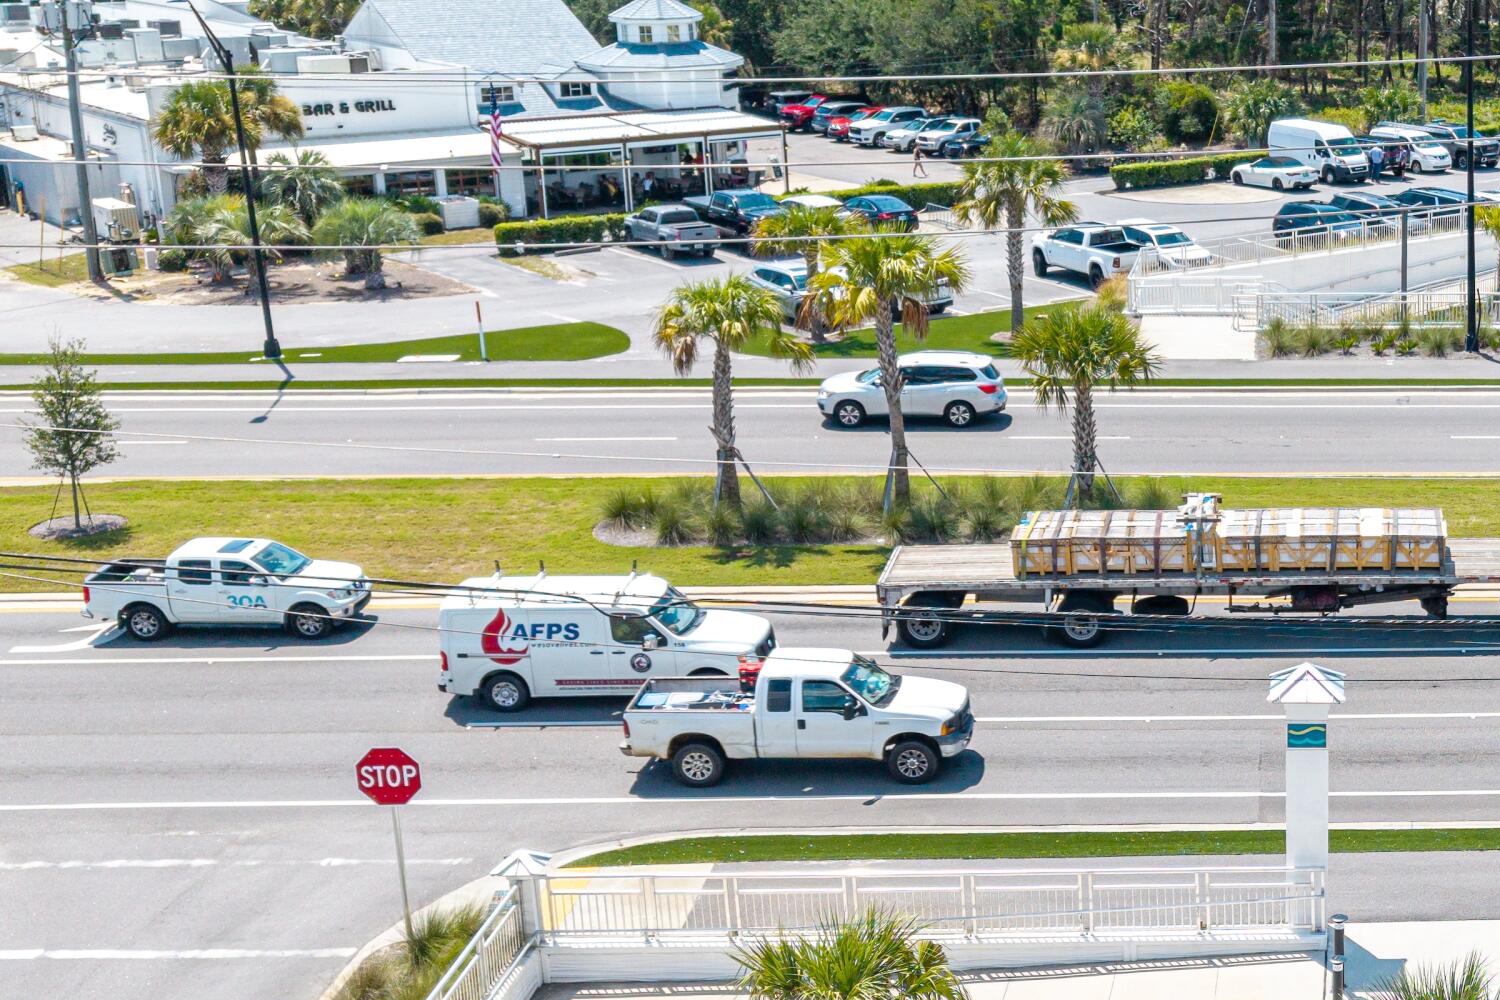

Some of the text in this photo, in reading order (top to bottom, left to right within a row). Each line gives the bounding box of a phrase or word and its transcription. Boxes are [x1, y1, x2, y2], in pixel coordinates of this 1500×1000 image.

[302, 99, 396, 117] BAR & GRILL
[510, 622, 580, 641] AFPS
[360, 764, 416, 788] STOP
